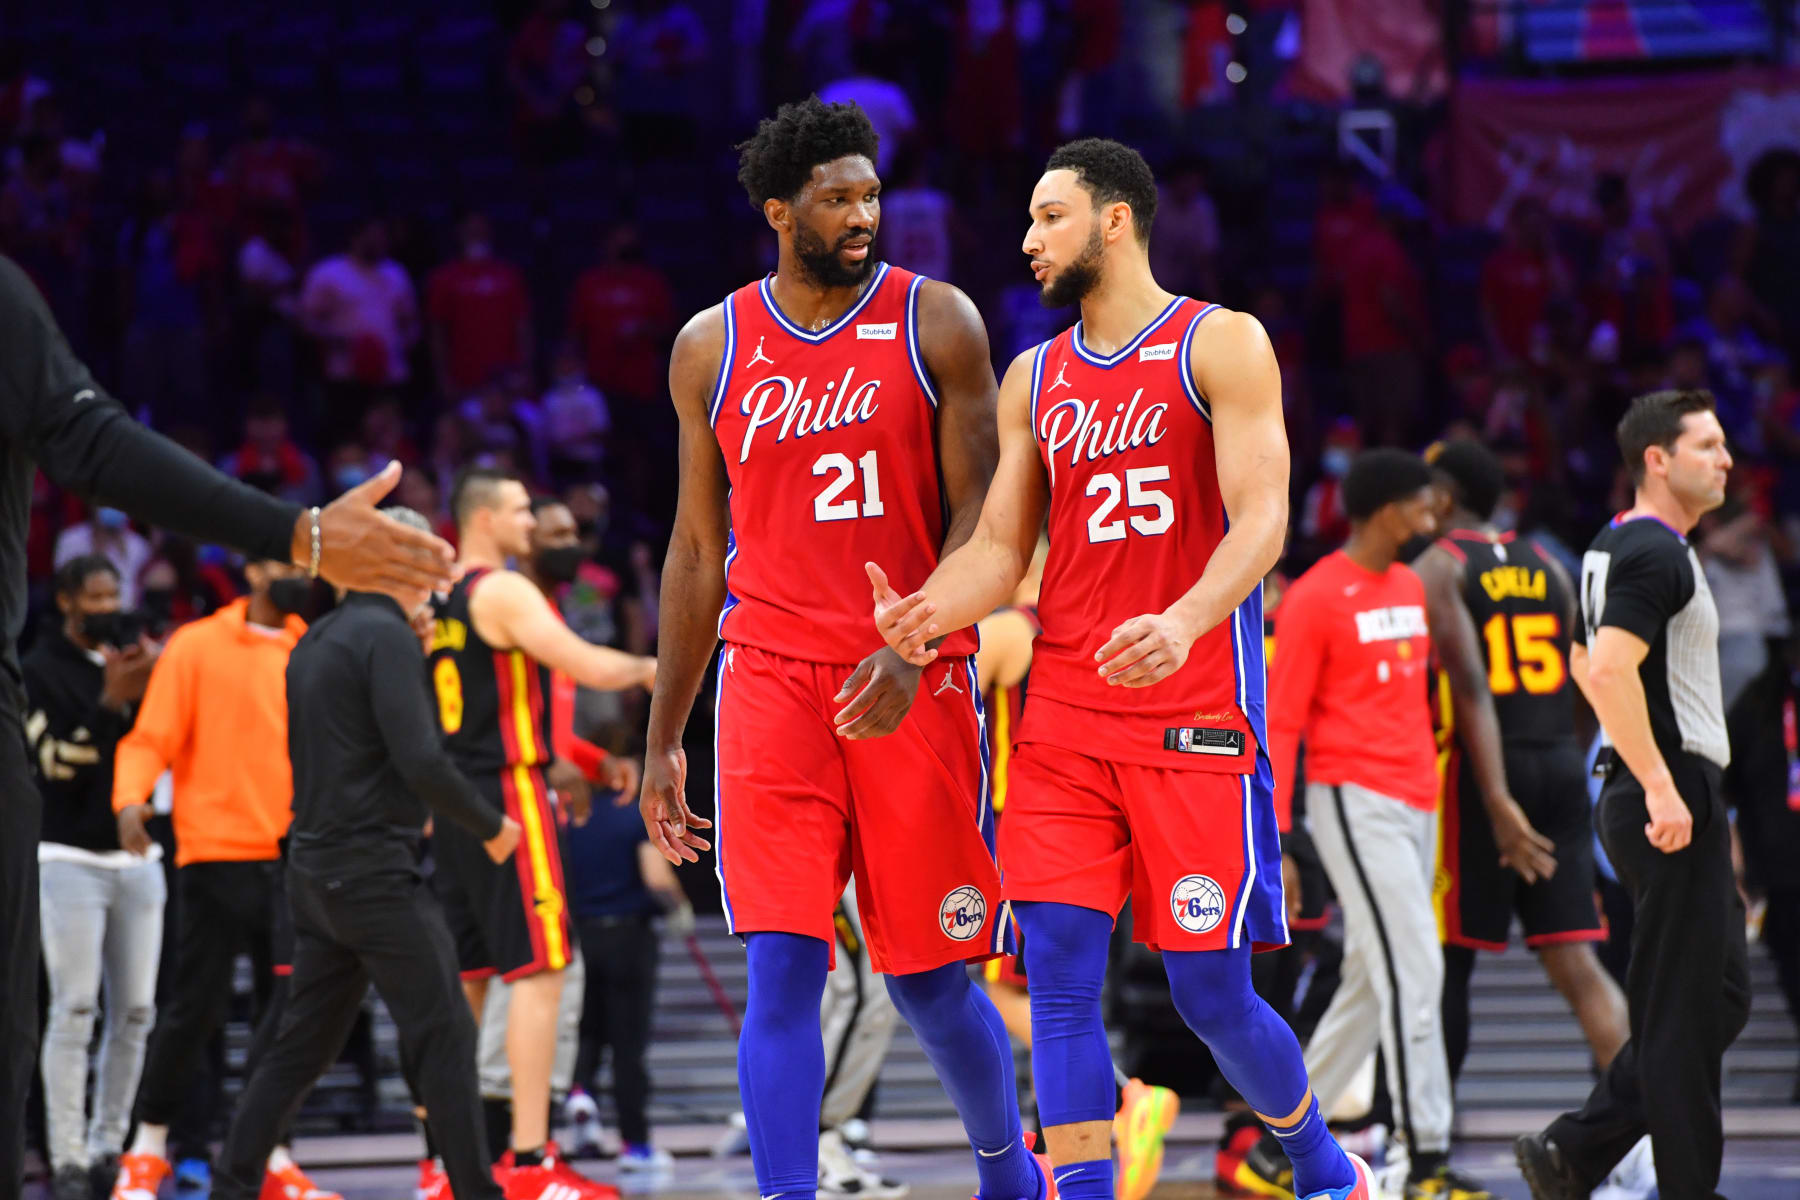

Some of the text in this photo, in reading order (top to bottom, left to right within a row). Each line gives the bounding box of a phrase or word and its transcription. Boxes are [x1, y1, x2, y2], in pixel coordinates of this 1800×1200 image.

[1144, 349, 1172, 357] StubHub
[739, 366, 881, 464] Phila
[1040, 388, 1168, 488] Phila
[812, 449, 885, 522] 21
[1085, 465, 1175, 544] 25
[1484, 612, 1566, 694] 15
[945, 907, 983, 930] 76ers
[1176, 897, 1220, 918] 76ers
